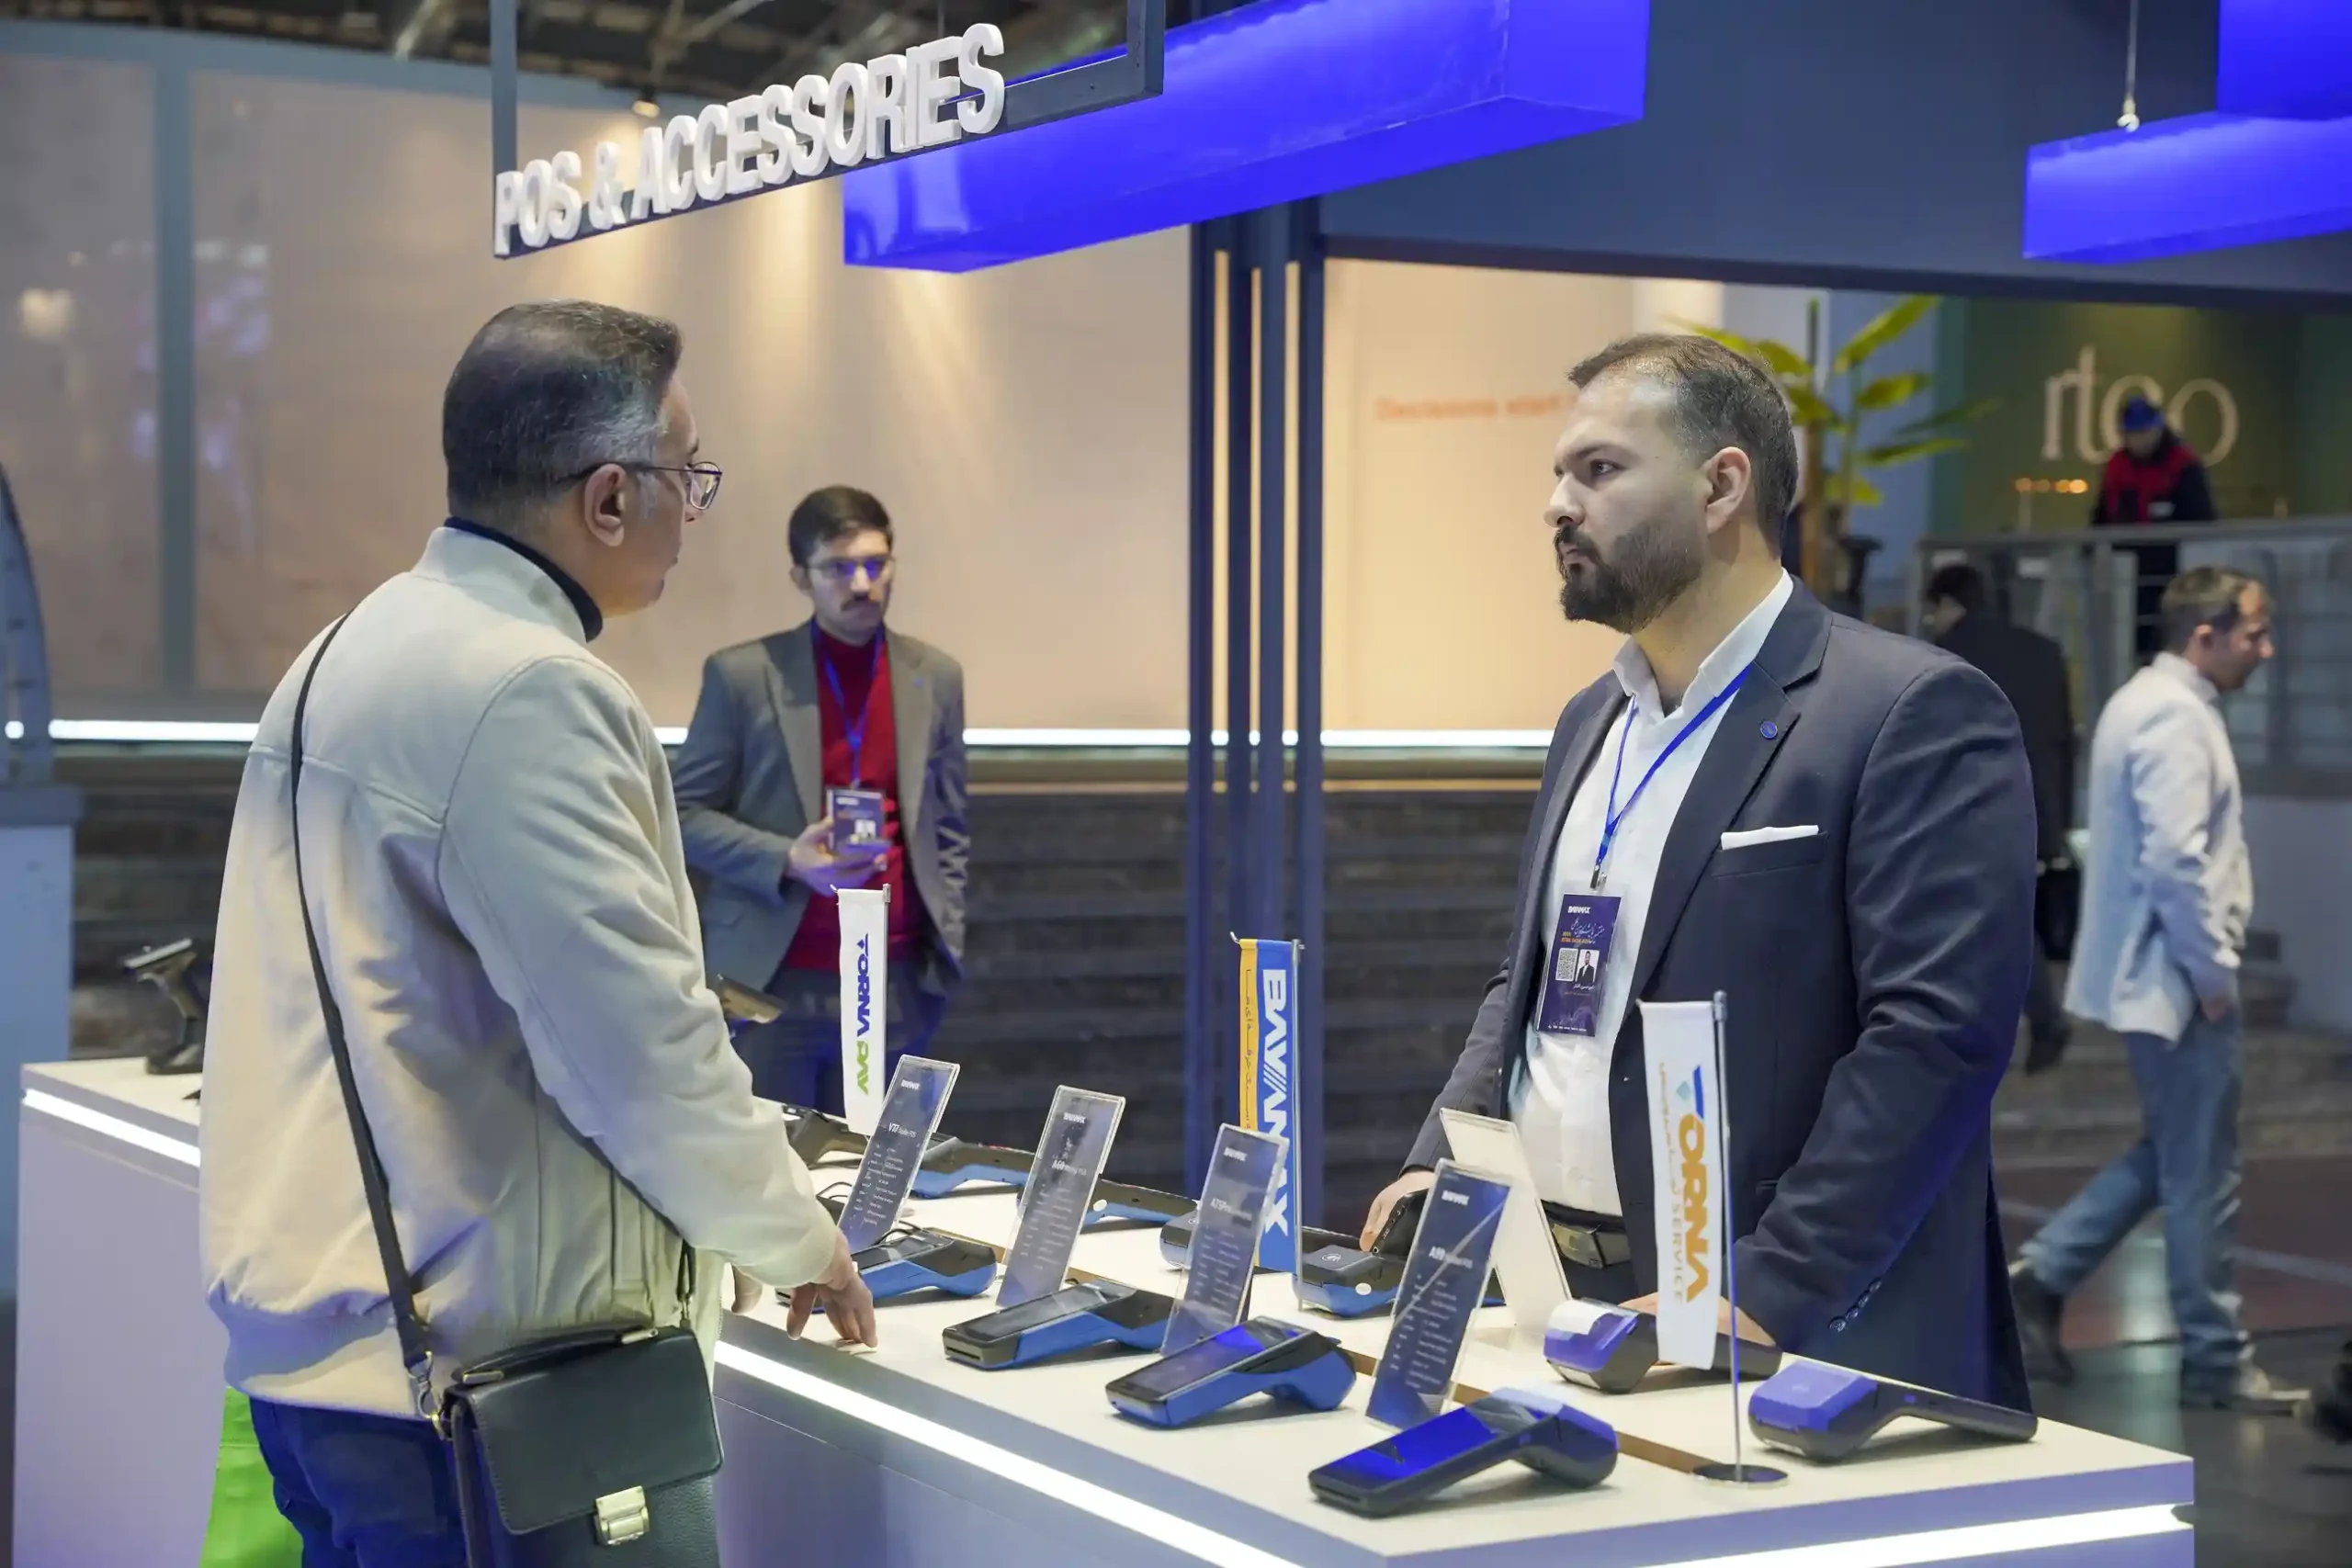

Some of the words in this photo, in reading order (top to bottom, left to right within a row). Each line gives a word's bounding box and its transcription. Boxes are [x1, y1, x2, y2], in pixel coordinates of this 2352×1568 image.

[495, 151, 582, 254] POS
[588, 141, 626, 230] &
[630, 23, 1004, 220] ACCESSORIES
[856, 932, 871, 1036] TORNA
